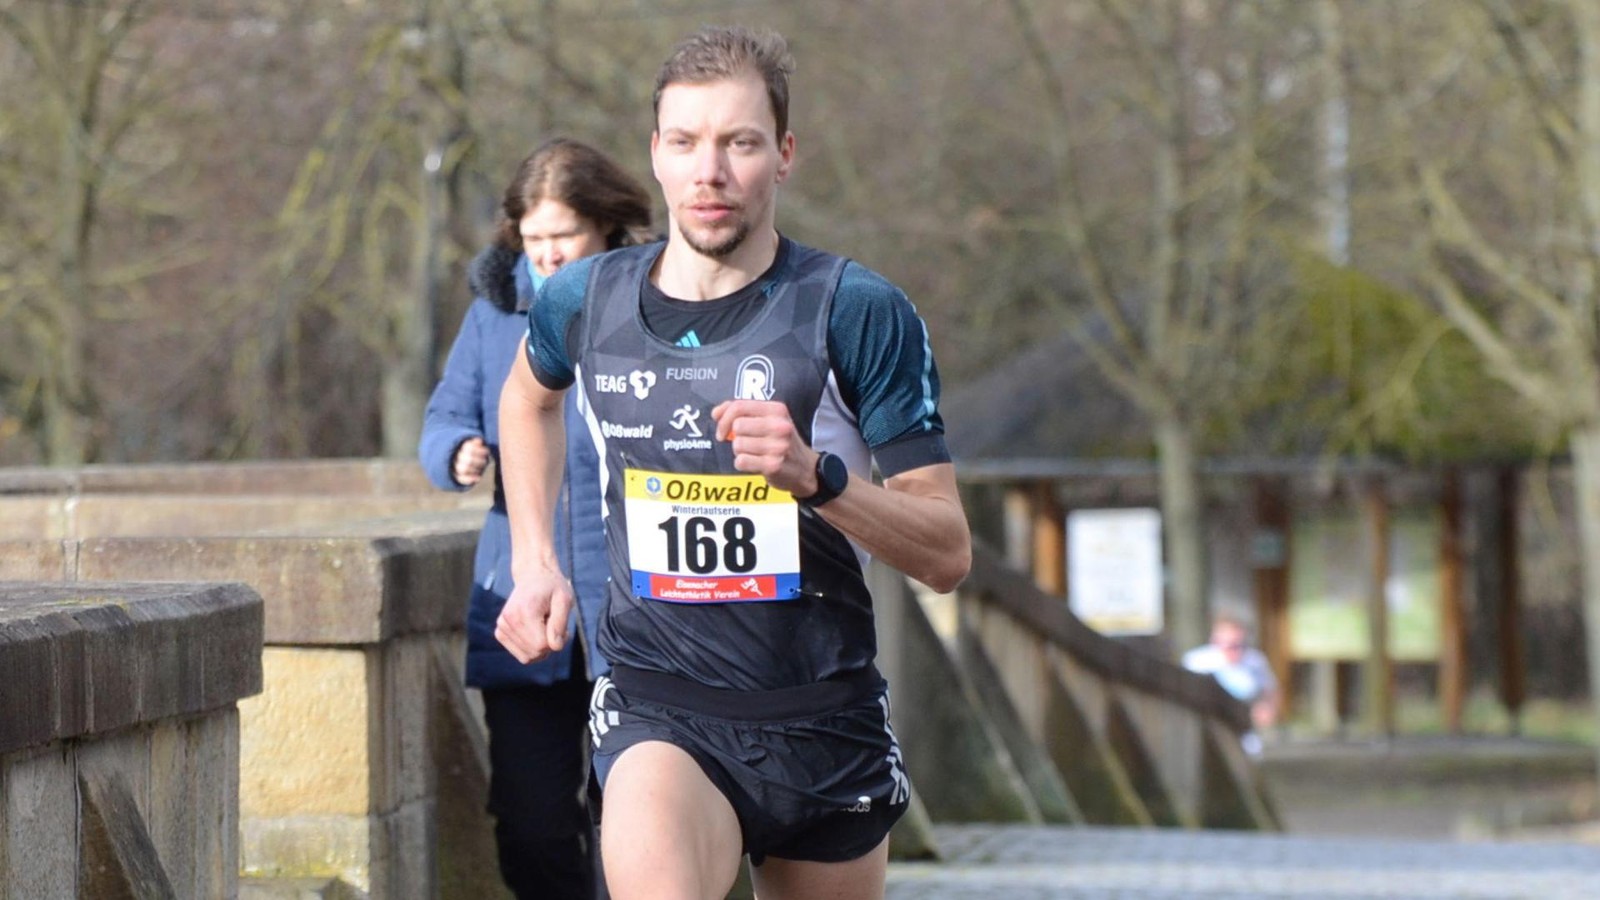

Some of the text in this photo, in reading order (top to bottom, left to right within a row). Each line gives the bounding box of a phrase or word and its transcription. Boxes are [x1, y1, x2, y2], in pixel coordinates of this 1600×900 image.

[666, 367, 718, 380] FUSION
[594, 374, 627, 393] TEAG
[741, 368, 766, 400] R
[663, 439, 712, 451] physio4me
[666, 479, 770, 502] Oßwald
[671, 505, 740, 515] Winterlaufserie
[658, 516, 757, 574] 168
[714, 590, 740, 599] Verein
